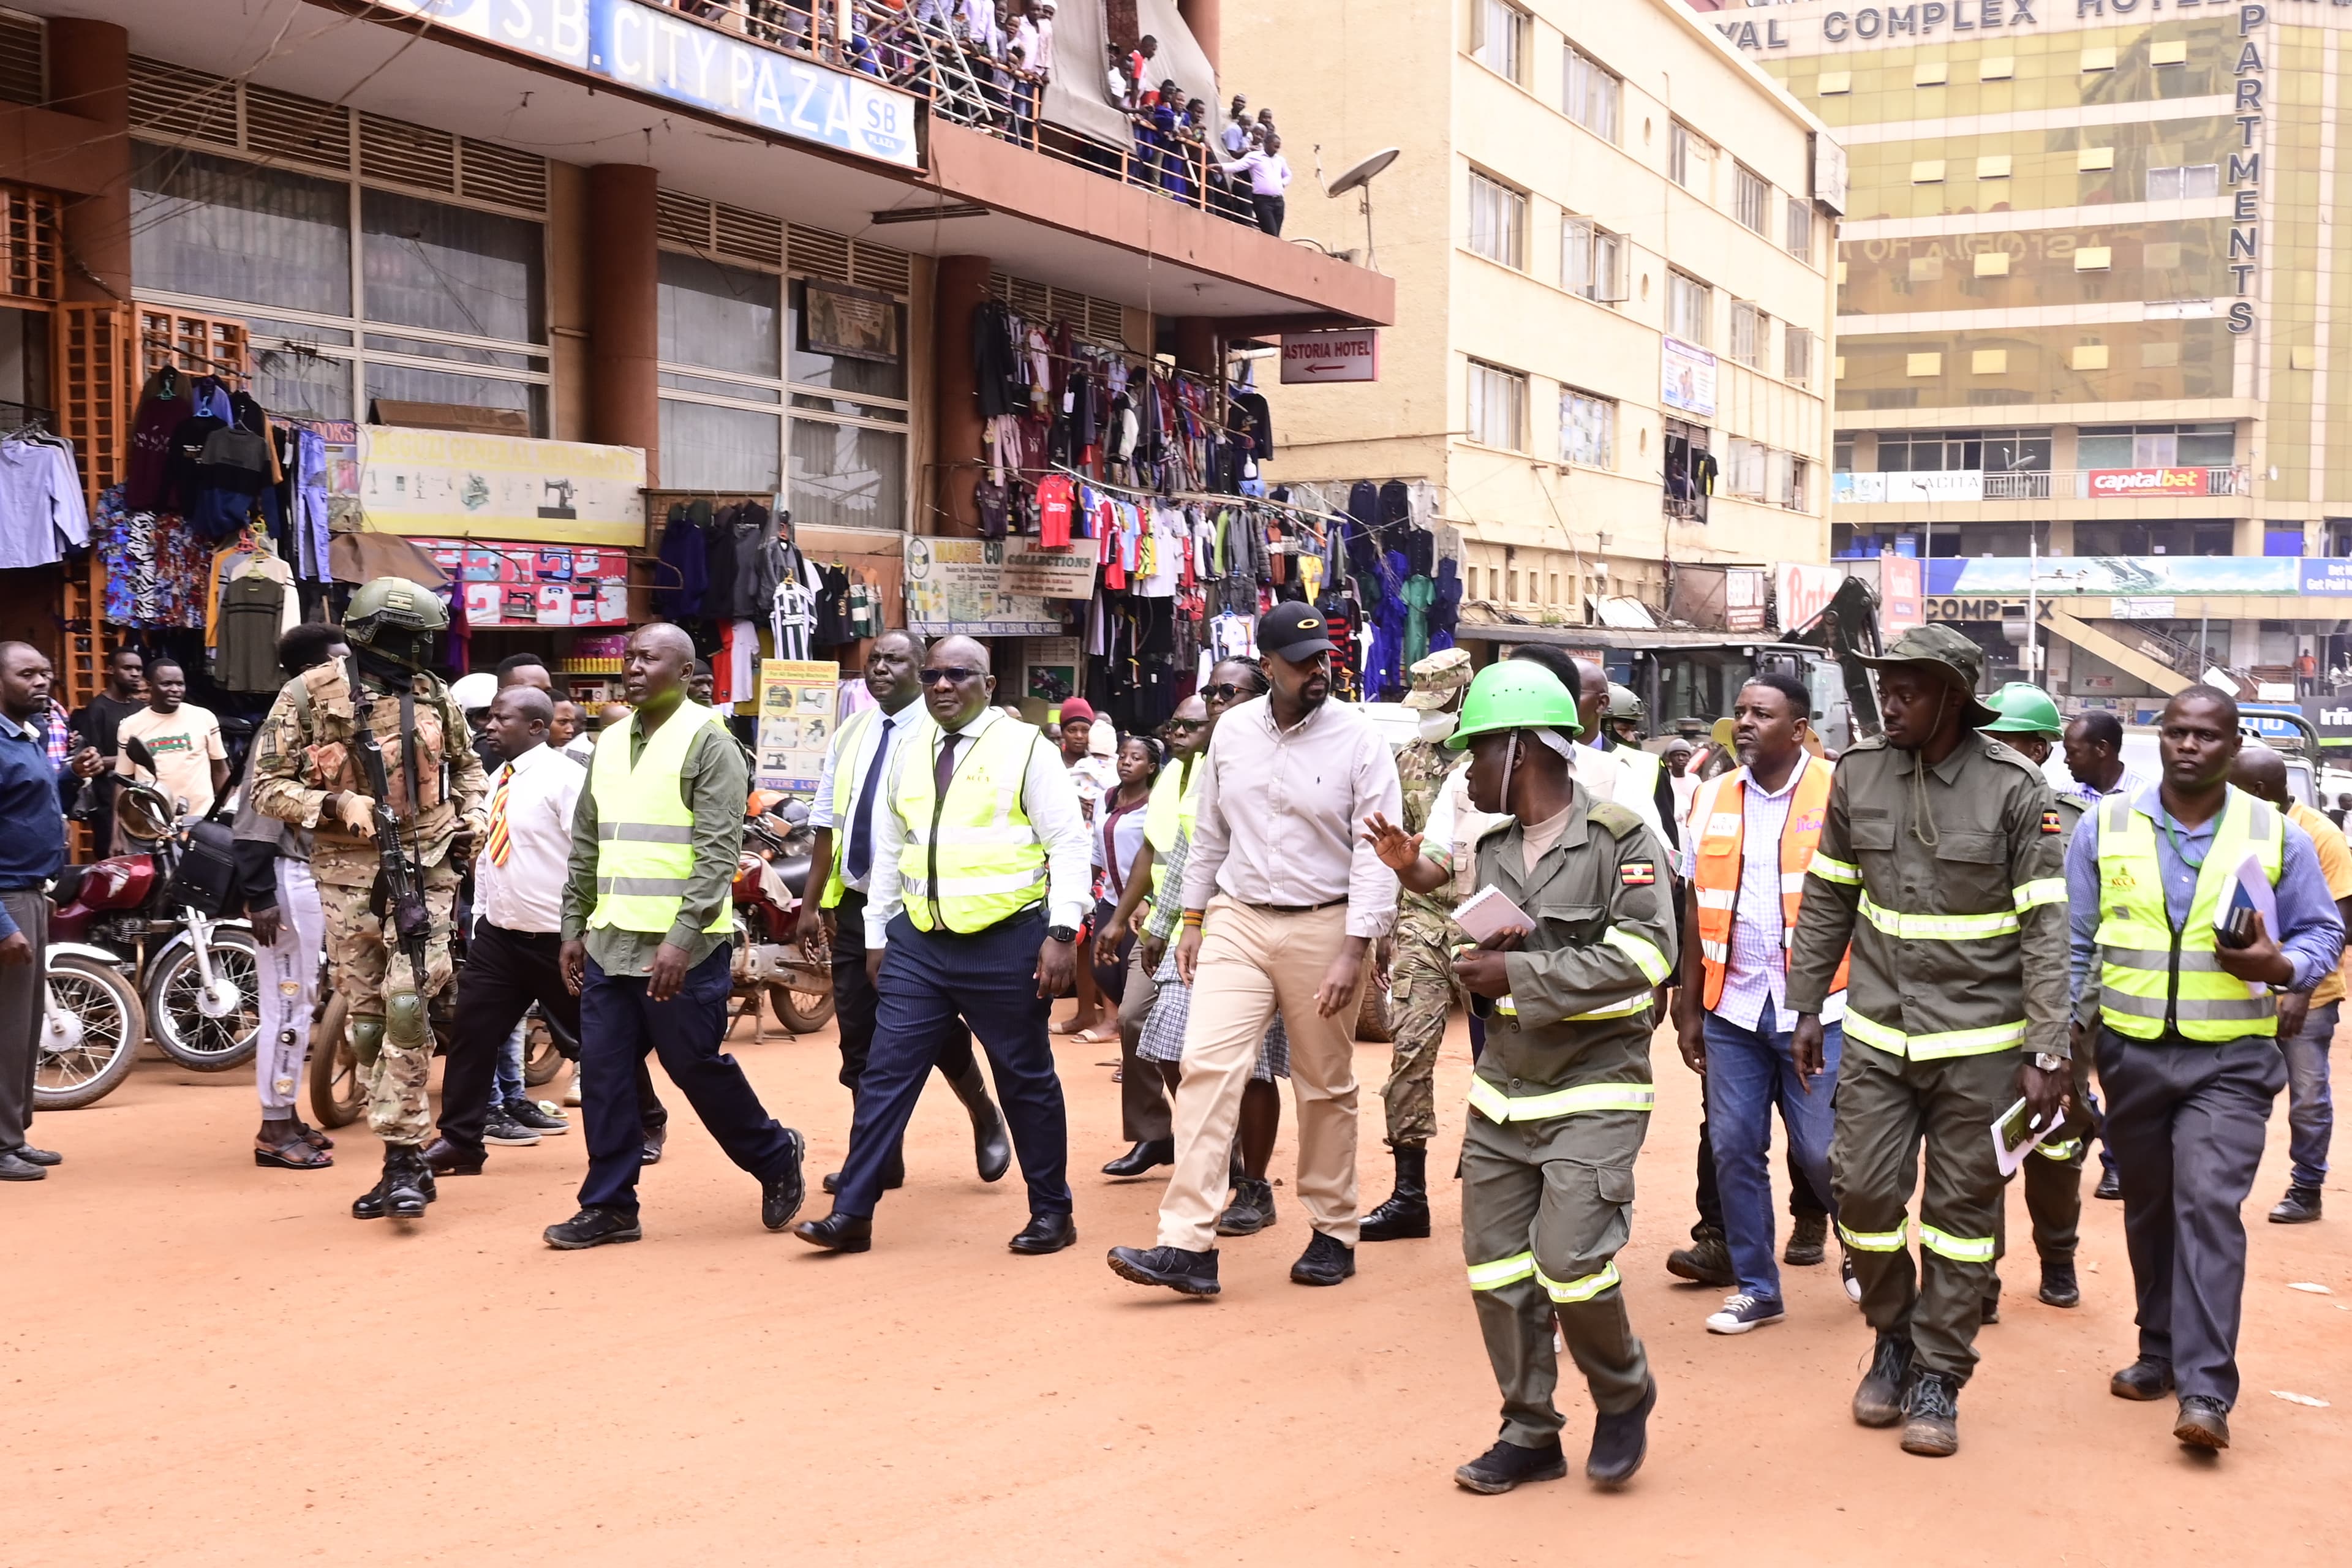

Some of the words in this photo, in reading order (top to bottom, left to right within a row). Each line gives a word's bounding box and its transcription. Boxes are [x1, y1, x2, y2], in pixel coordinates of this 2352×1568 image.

[1823, 0, 2037, 42] COMPLEX
[612, 7, 717, 99] CITY
[731, 48, 851, 141] PAZA
[867, 98, 895, 134] SB
[868, 134, 896, 150] PLAZA
[1283, 342, 1331, 360] ASTORIA
[1335, 341, 1370, 357] HOTEL
[450, 437, 531, 466] GENERAL
[2094, 469, 2199, 491] capitalbet
[1008, 554, 1091, 568] COLLECTIONS
[1921, 598, 2054, 620] COMPX
